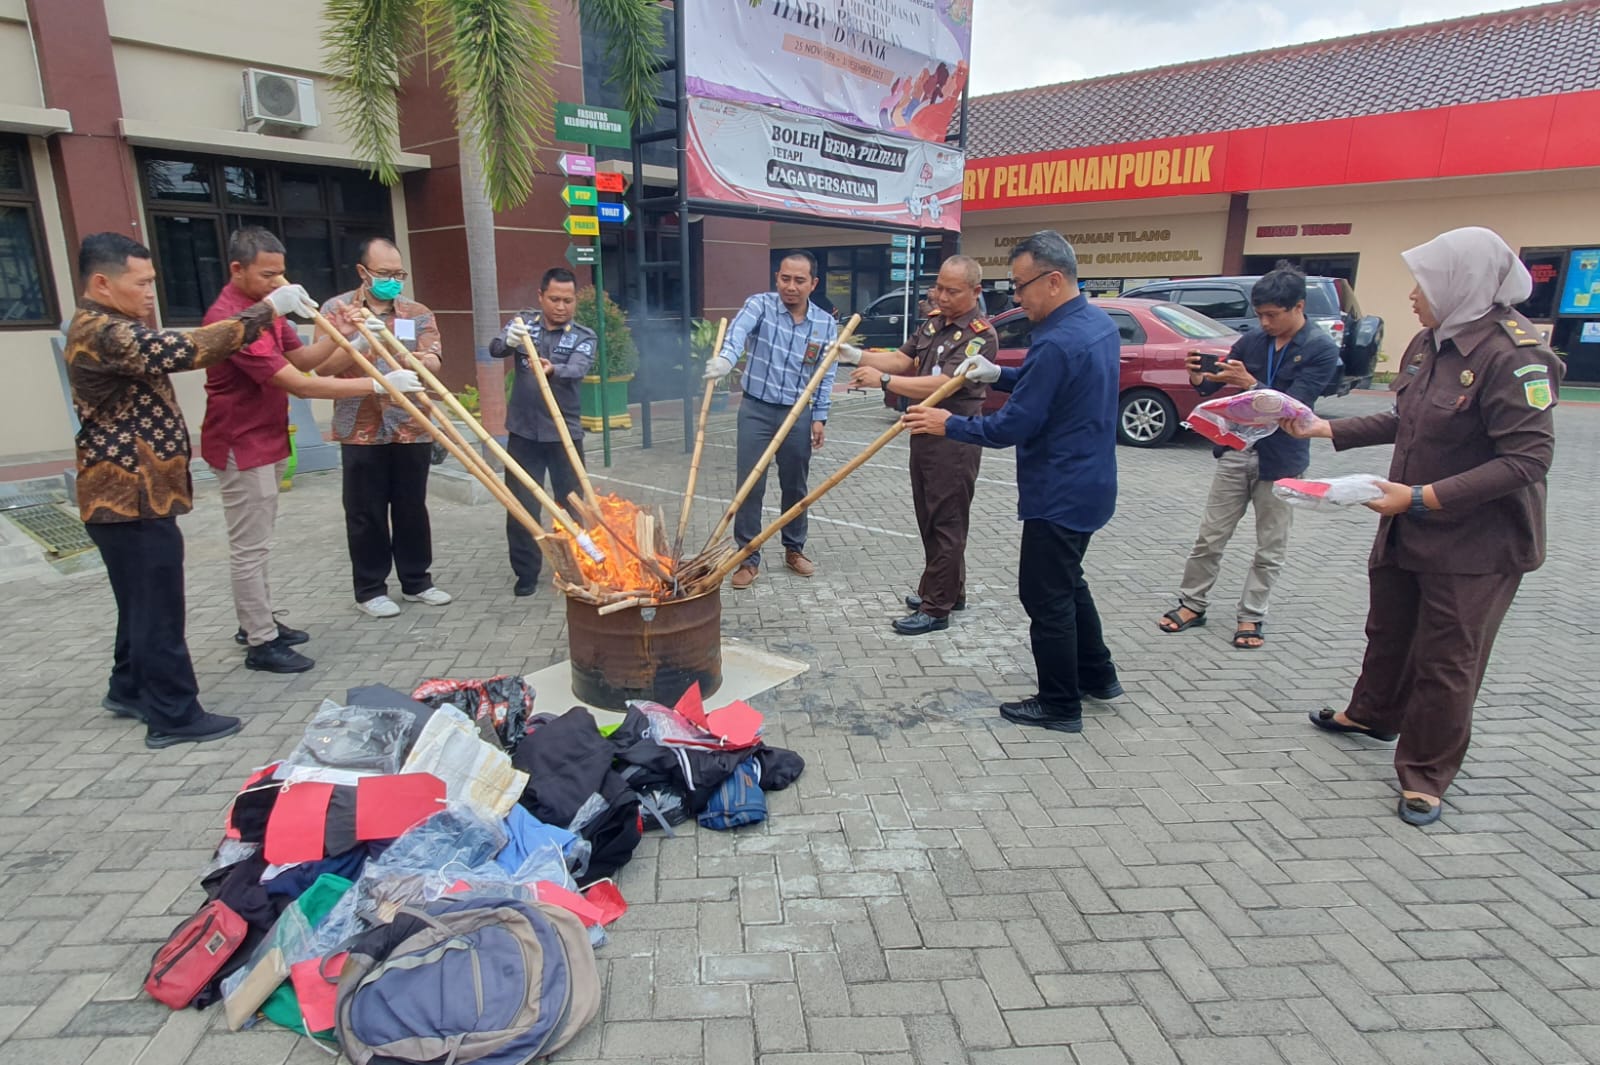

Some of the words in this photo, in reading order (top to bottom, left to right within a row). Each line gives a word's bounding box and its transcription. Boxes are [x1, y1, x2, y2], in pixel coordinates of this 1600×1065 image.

[836, 8, 902, 49] PREMPUAN
[564, 115, 599, 130] KELOMPOK
[577, 108, 609, 122] FASILITAS
[771, 124, 820, 149] BOLEH
[823, 136, 856, 159] BEDA
[857, 142, 905, 168] PILIHAN
[771, 146, 803, 163] TETAPI
[768, 165, 807, 188] JAGA
[807, 174, 876, 198] PERSATUAN
[962, 168, 990, 201] RY
[600, 207, 621, 217] TOILET
[994, 236, 1022, 249] LOK
[1064, 232, 1114, 245] AYANAN
[1117, 229, 1171, 243] TILANG
[1096, 250, 1203, 264] GUNUNGKIDUL
